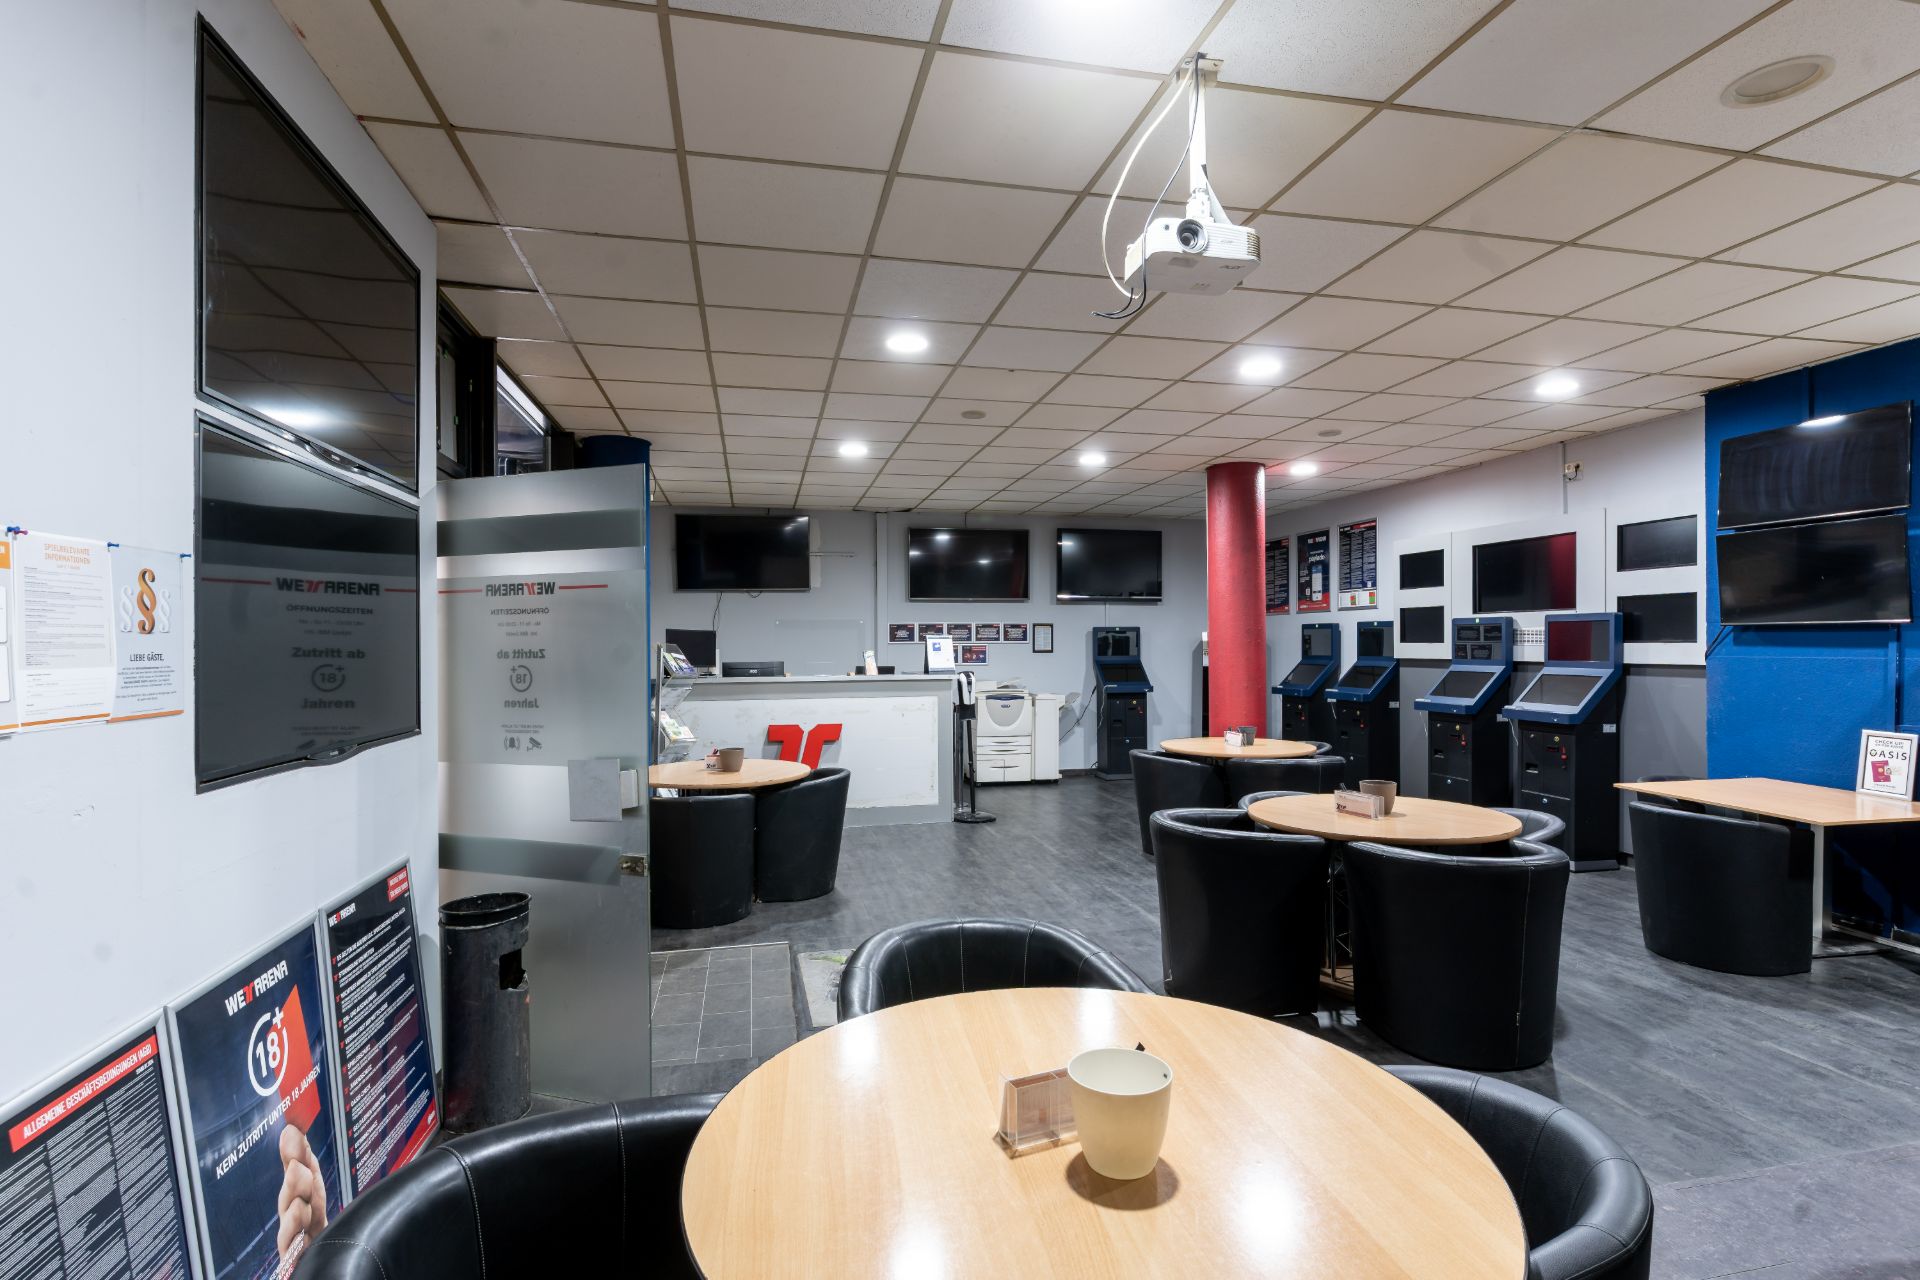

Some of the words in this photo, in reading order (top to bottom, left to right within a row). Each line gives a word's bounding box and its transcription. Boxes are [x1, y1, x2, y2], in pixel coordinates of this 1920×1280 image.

[130, 653, 146, 662] LIEBE
[291, 646, 343, 659] Zutritt
[346, 647, 366, 660] ab
[301, 697, 355, 709] Jahren
[1870, 749, 1907, 760] OASIS
[23, 1101, 67, 1139] ALLGEMEINE
[65, 1054, 138, 1110] GESCHÄFTSBEDINGUNGEN
[216, 1149, 238, 1180] KEIN
[237, 1117, 269, 1160] ZUTRITT
[268, 1096, 292, 1127] UNTER
[291, 1087, 300, 1102] 18
[300, 1062, 321, 1094] JAHREN
